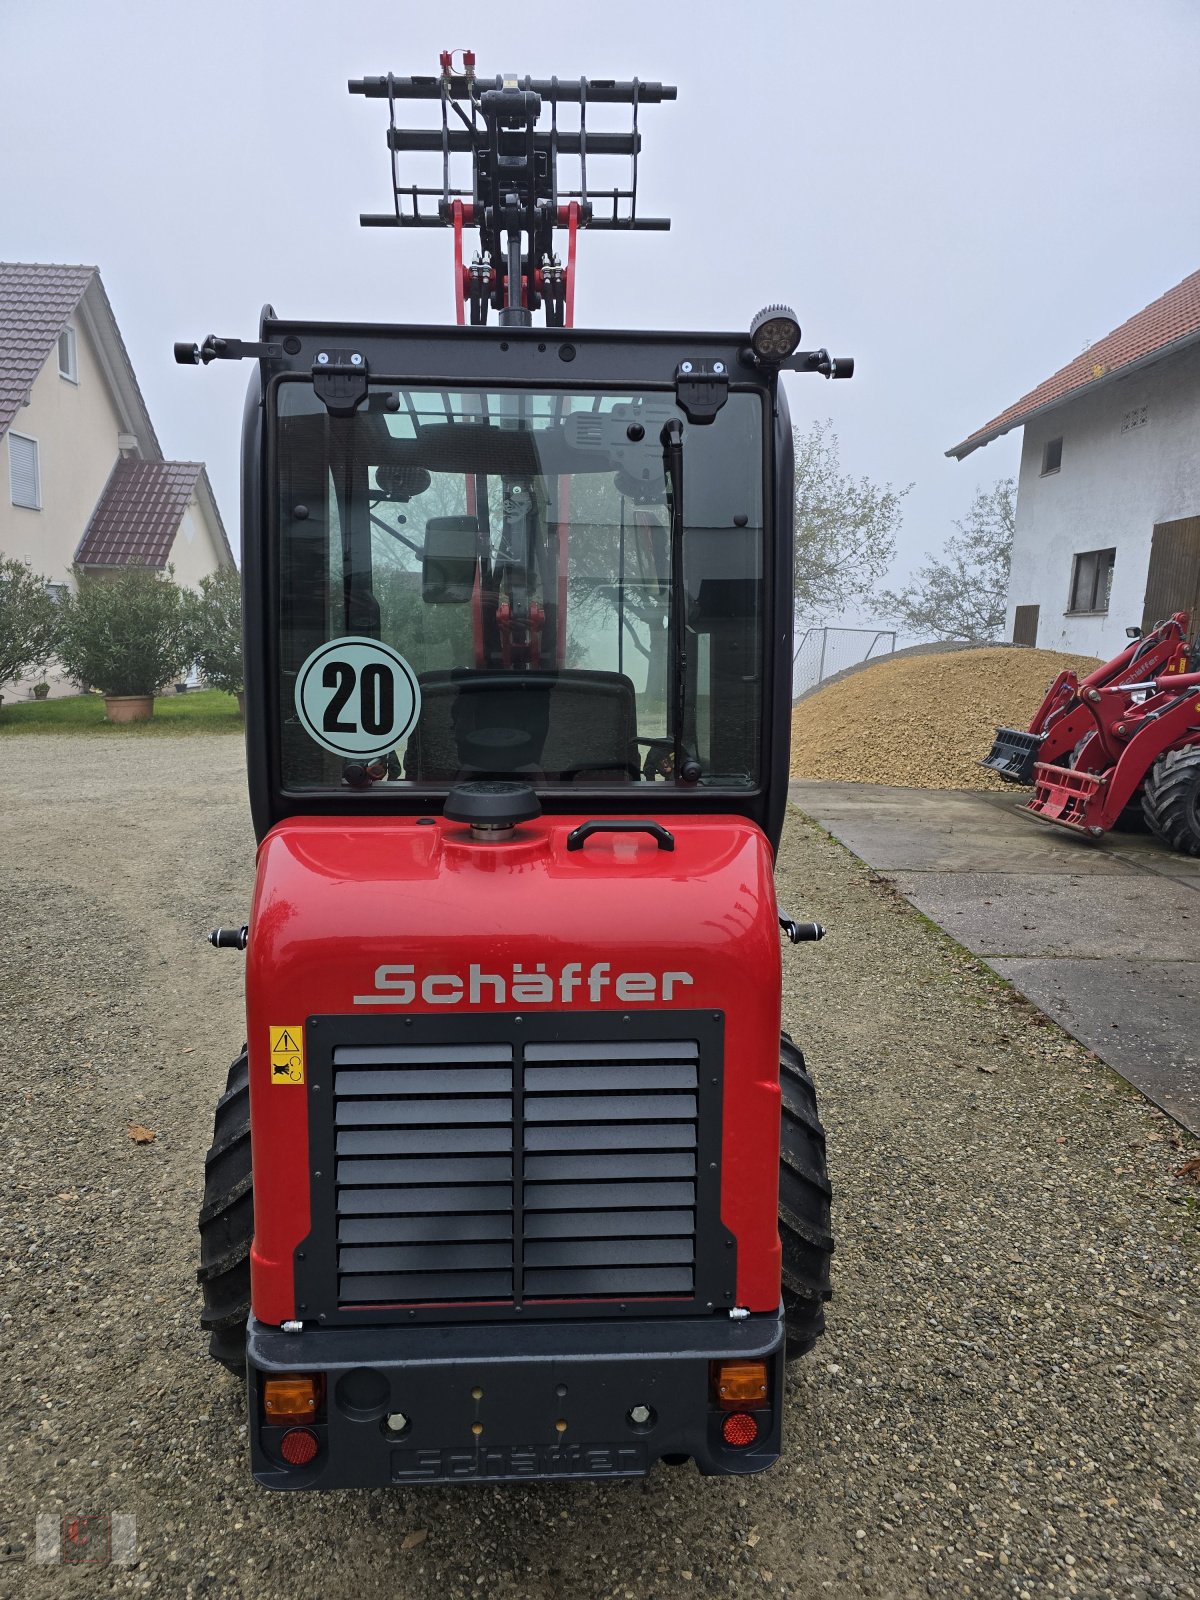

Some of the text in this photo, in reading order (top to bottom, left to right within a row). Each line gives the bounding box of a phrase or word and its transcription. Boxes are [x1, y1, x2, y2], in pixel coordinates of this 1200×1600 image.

[322, 661, 395, 736] 20
[353, 962, 694, 1005] Schäffer
[398, 1444, 639, 1475] Schäffer
